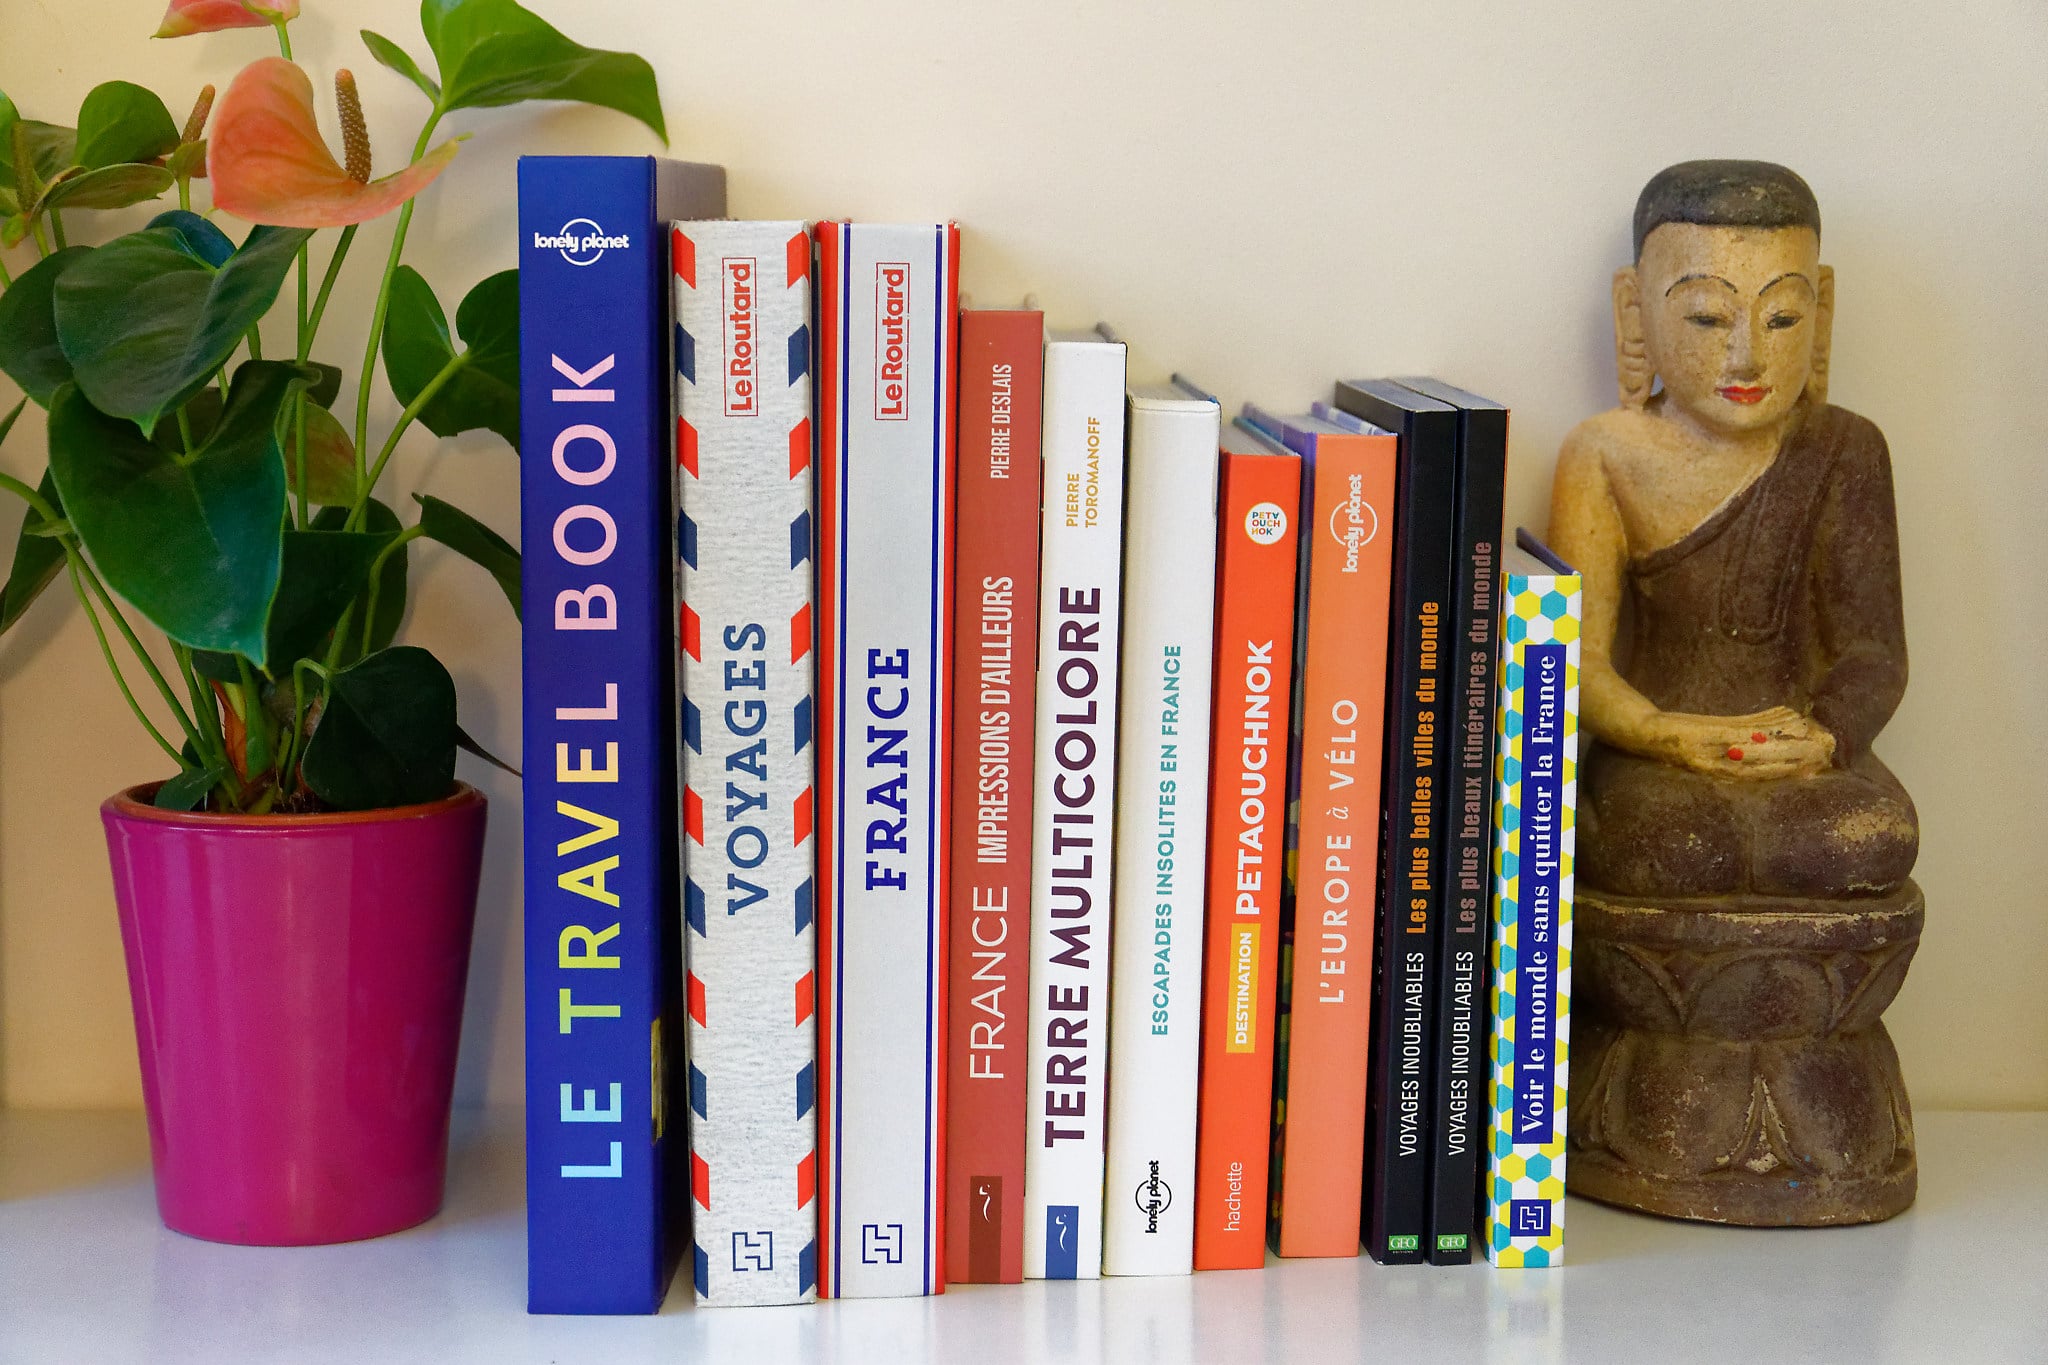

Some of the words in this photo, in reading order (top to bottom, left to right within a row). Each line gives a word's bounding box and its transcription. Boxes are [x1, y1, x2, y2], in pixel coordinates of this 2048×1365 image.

[535, 232, 579, 253] lonely
[582, 232, 630, 252] planet
[729, 264, 752, 377] Routard
[882, 269, 903, 380] Routard
[731, 380, 752, 410] Le
[881, 384, 902, 414] Le
[992, 365, 1011, 423] DESLAIS
[991, 428, 1010, 478] PIERRE
[1086, 417, 1100, 528] TOROMANOFF
[552, 354, 617, 630] BOOK
[1066, 474, 1079, 526] PIERRE
[1345, 474, 1364, 524] planet
[1342, 526, 1364, 573] lonely
[1472, 542, 1491, 610] monde
[981, 577, 1012, 704] D'AILLEURS
[1418, 602, 1439, 670] monde
[1468, 619, 1489, 643] du
[1162, 646, 1180, 735] FRANCE
[1416, 678, 1436, 703] du
[1463, 652, 1486, 767] itinéraires
[1532, 656, 1555, 744] France
[724, 624, 768, 915] VOYAGES
[866, 649, 909, 890] FRANCE
[1161, 745, 1177, 771] EN
[1325, 700, 1358, 790] VÉLO
[1414, 712, 1434, 767] villes
[1531, 754, 1552, 777] la
[977, 711, 1010, 863] IMPRESSIONS
[1049, 587, 1100, 969] MULTICOLORE
[1236, 640, 1272, 914] PETAOUCHNOK
[1410, 777, 1431, 838] belles
[1460, 777, 1481, 837] beaux
[1157, 781, 1176, 894] INSOLITES
[1327, 807, 1348, 819] à
[1530, 787, 1557, 876] quitter
[556, 683, 620, 1033] TRAVEL
[1409, 848, 1430, 889] plus
[1459, 847, 1480, 889] plus
[1320, 836, 1351, 1002] L'EUROPE
[1407, 899, 1426, 933] Les
[1456, 899, 1476, 932] Les
[1534, 886, 1549, 942] sans
[970, 887, 1007, 1078] FRANCE
[1152, 904, 1171, 1035] ESCAPADES
[1236, 933, 1251, 1044] DESTINATION
[1526, 952, 1547, 1039] monde
[1403, 953, 1424, 1074] INOUBLIABLES
[1452, 952, 1473, 1073] INOUBLIABLES
[1045, 985, 1088, 1147] TERRE
[1523, 1048, 1546, 1071] le
[560, 1083, 622, 1177] LE
[1400, 1081, 1419, 1156] VOYAGES
[1449, 1080, 1467, 1155] VOYAGES
[1522, 1079, 1543, 1133] Voir
[1147, 1160, 1161, 1197] planet
[1224, 1163, 1242, 1230] hachette
[1145, 1199, 1161, 1233] lonely
[1390, 1237, 1417, 1249] GEO
[1440, 1236, 1465, 1248] GEO
